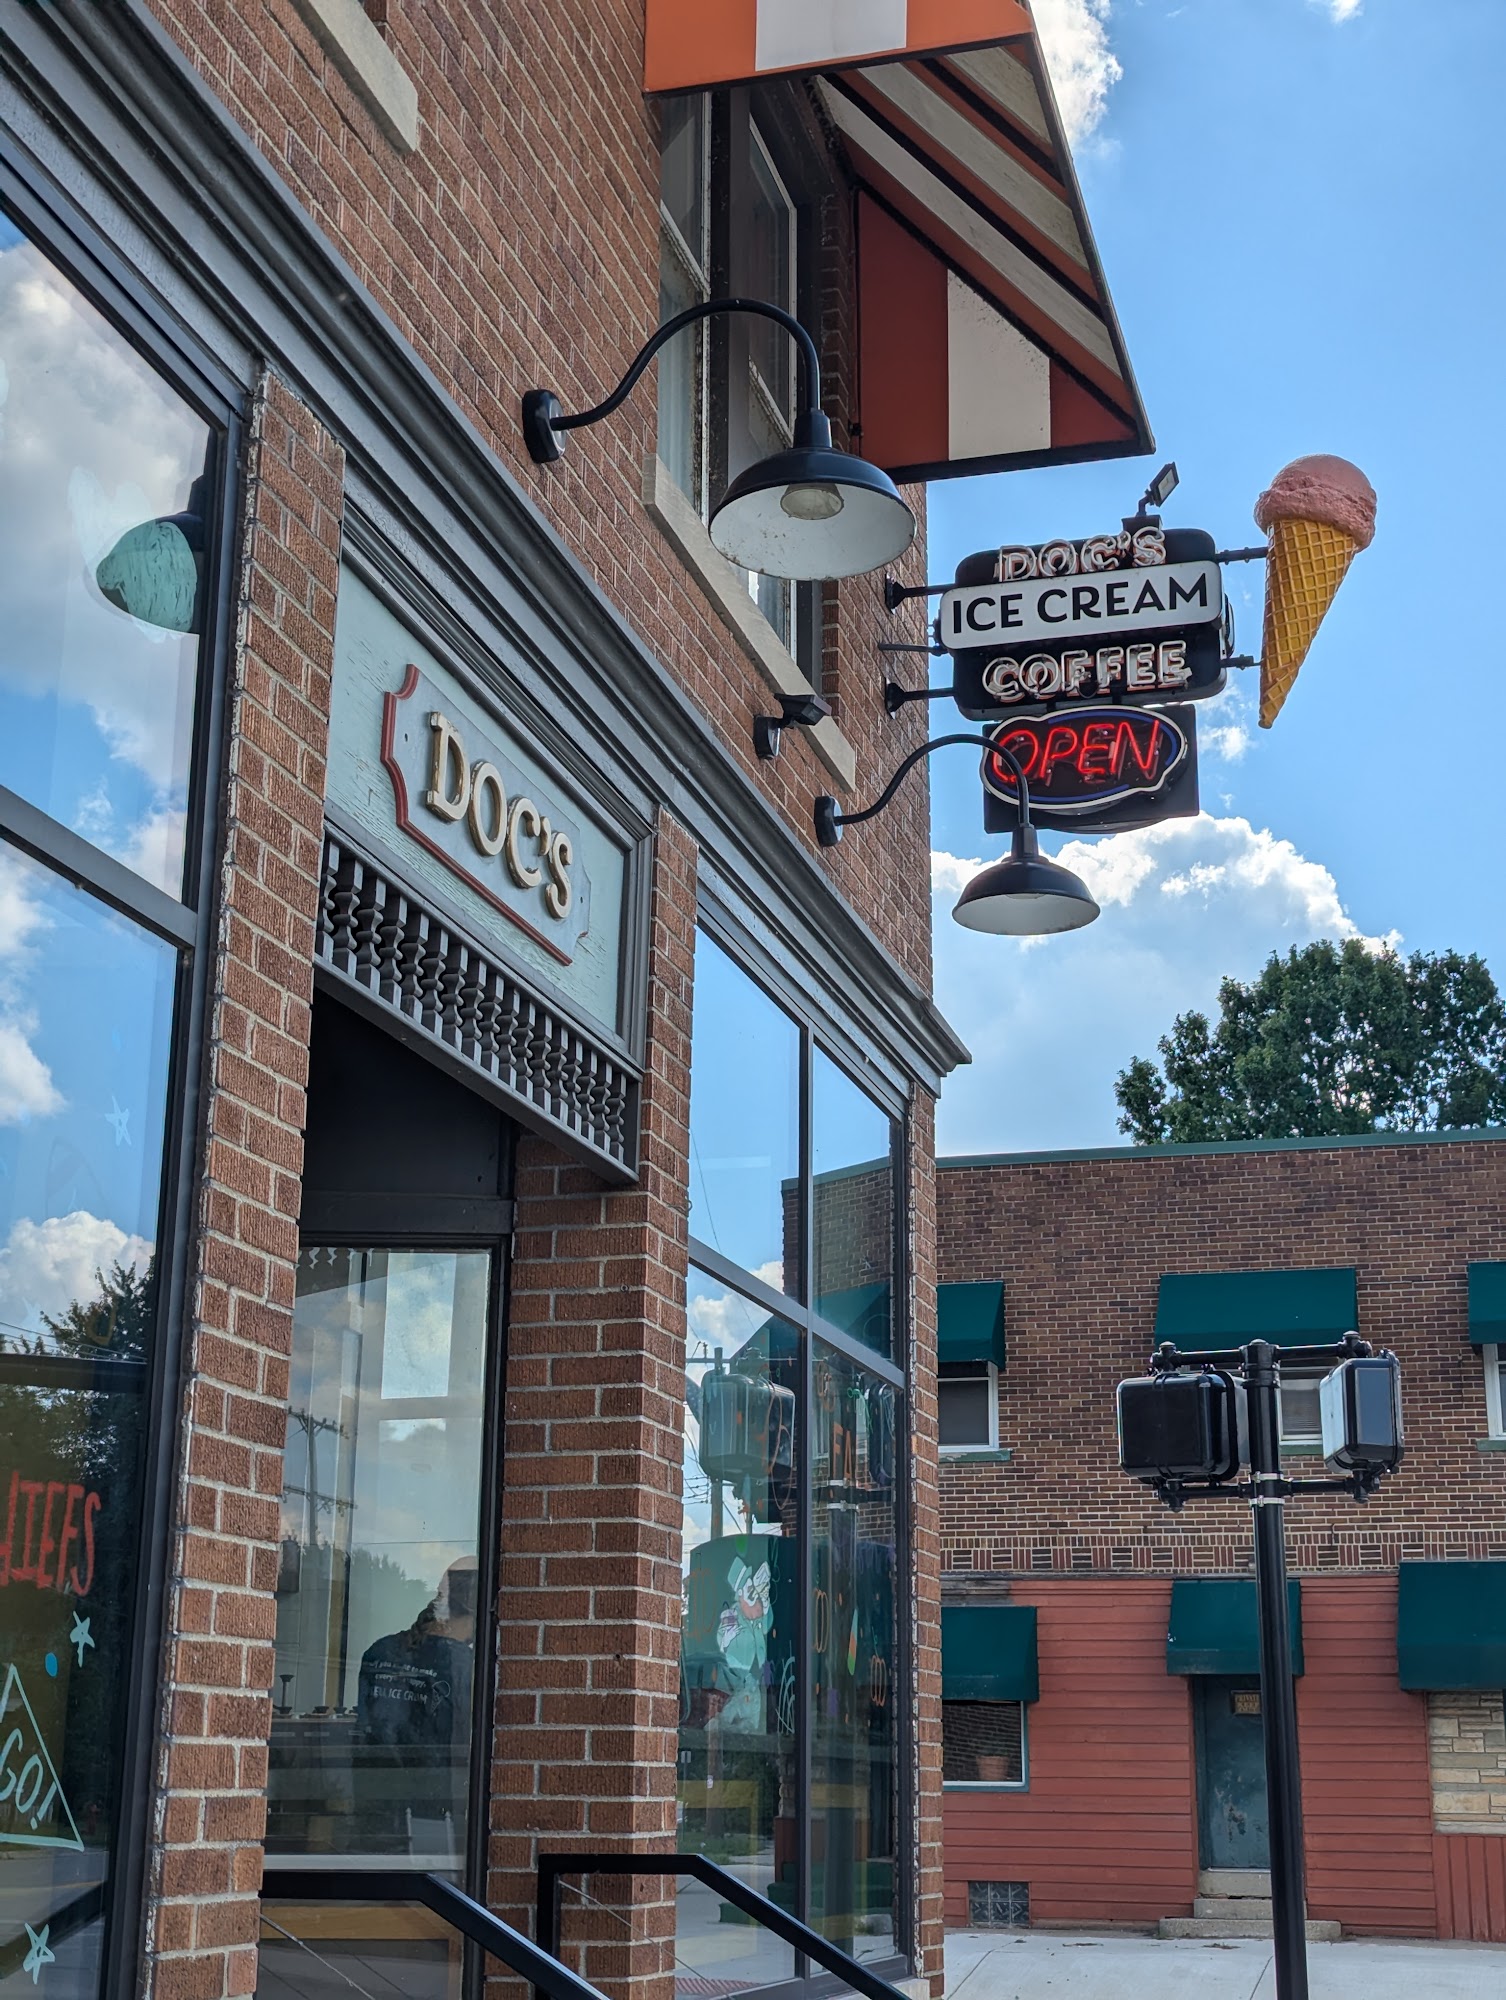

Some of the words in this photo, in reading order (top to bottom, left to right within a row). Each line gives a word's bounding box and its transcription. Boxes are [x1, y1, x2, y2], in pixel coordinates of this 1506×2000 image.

[994, 527, 1167, 582] DOC'S
[953, 593, 1023, 634] ICE
[1037, 573, 1208, 623] CREAM
[982, 640, 1192, 702] COFFEE
[991, 718, 1162, 788] OPEN
[426, 711, 572, 918] DOC'S
[388, 1688, 402, 1699] ICE
[0, 1727, 58, 1831] GO!
